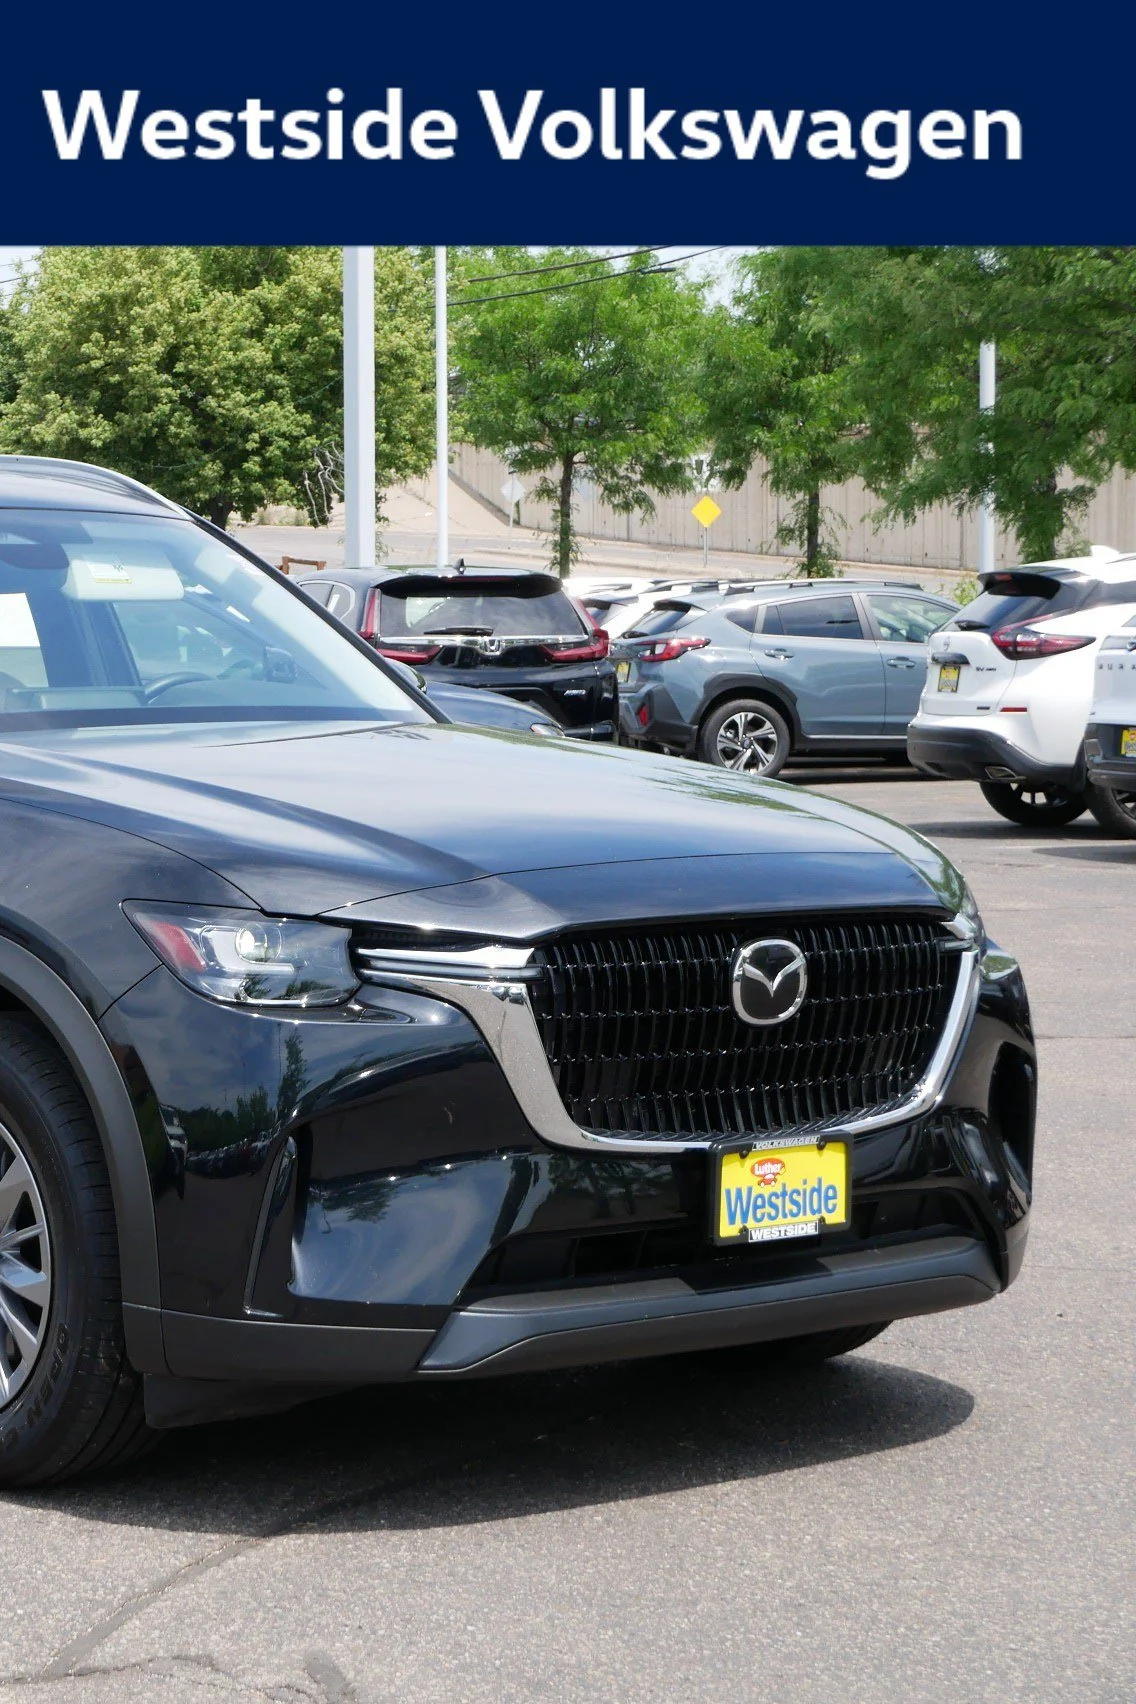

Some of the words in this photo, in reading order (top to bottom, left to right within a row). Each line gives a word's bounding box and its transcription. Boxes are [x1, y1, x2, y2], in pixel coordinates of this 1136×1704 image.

[755, 1136, 819, 1150] VOLKSWAGEN
[754, 1161, 784, 1175] Luther
[725, 1177, 838, 1226] Westside
[750, 1222, 817, 1241] WESTSIDE
